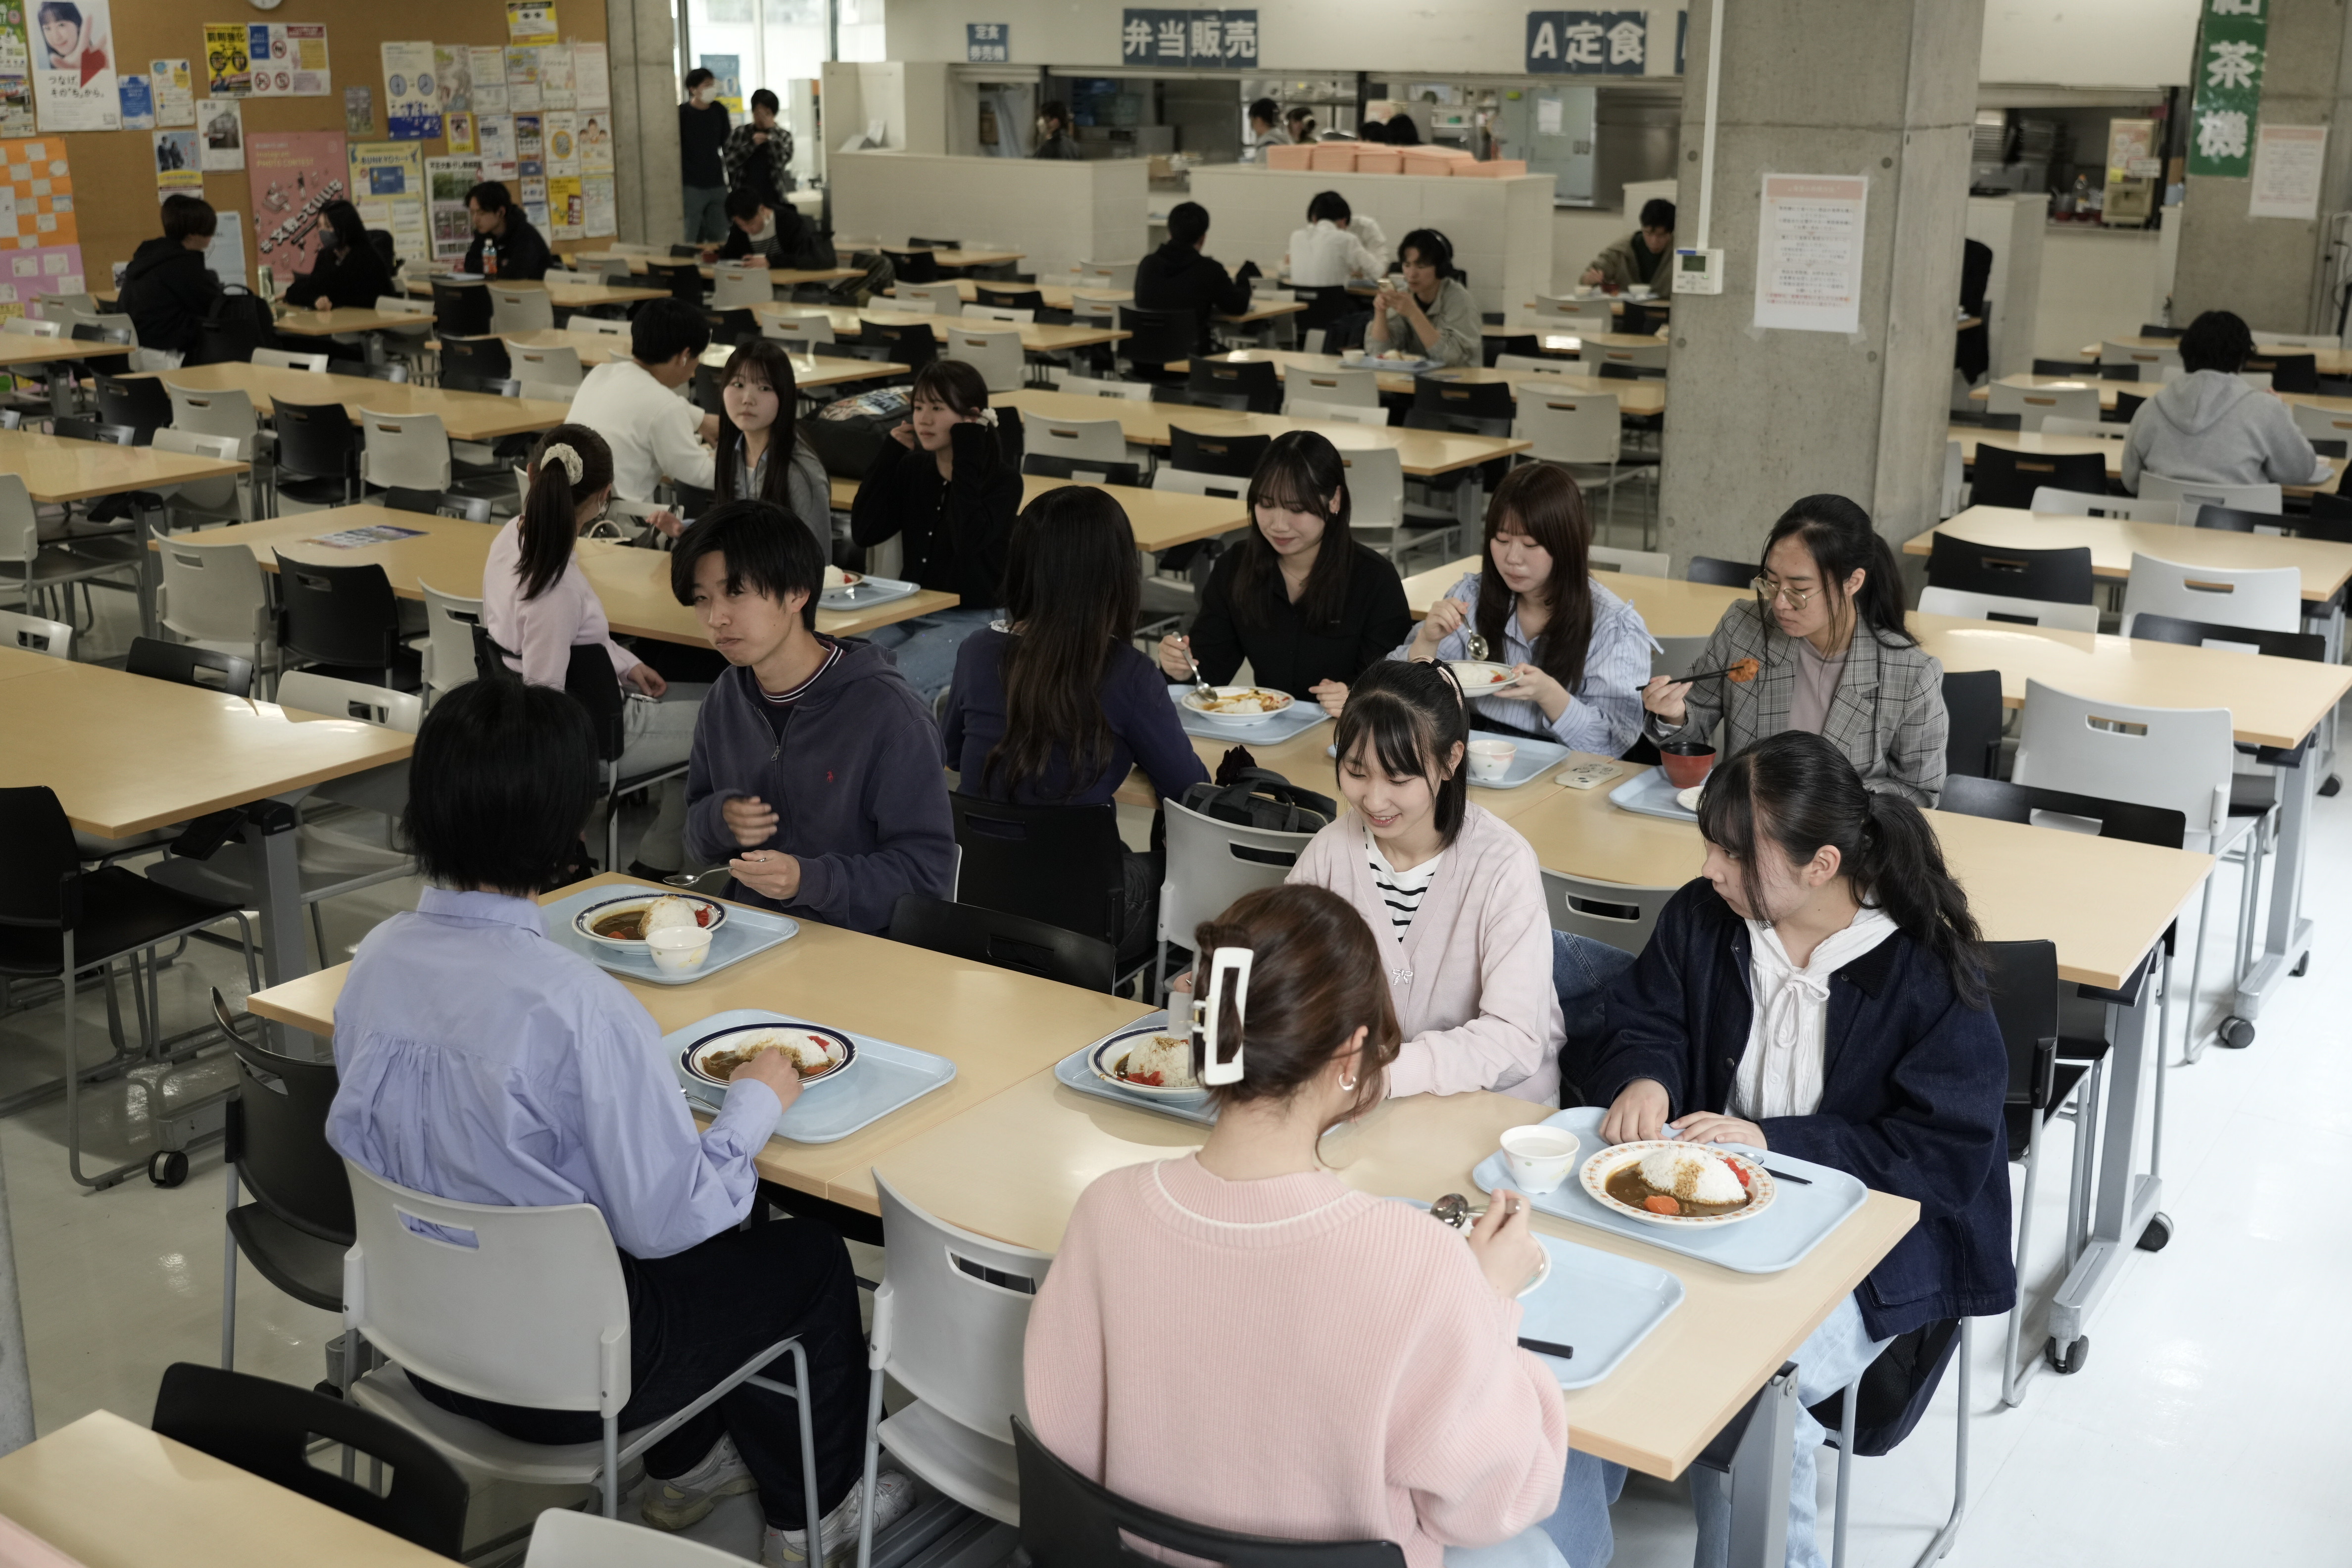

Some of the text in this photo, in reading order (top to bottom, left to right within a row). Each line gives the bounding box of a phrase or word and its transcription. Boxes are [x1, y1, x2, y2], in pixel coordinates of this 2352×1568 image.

[975, 25, 1000, 40] 定食
[1124, 19, 1257, 58] 弁当販売
[1531, 21, 1645, 65] A定食
